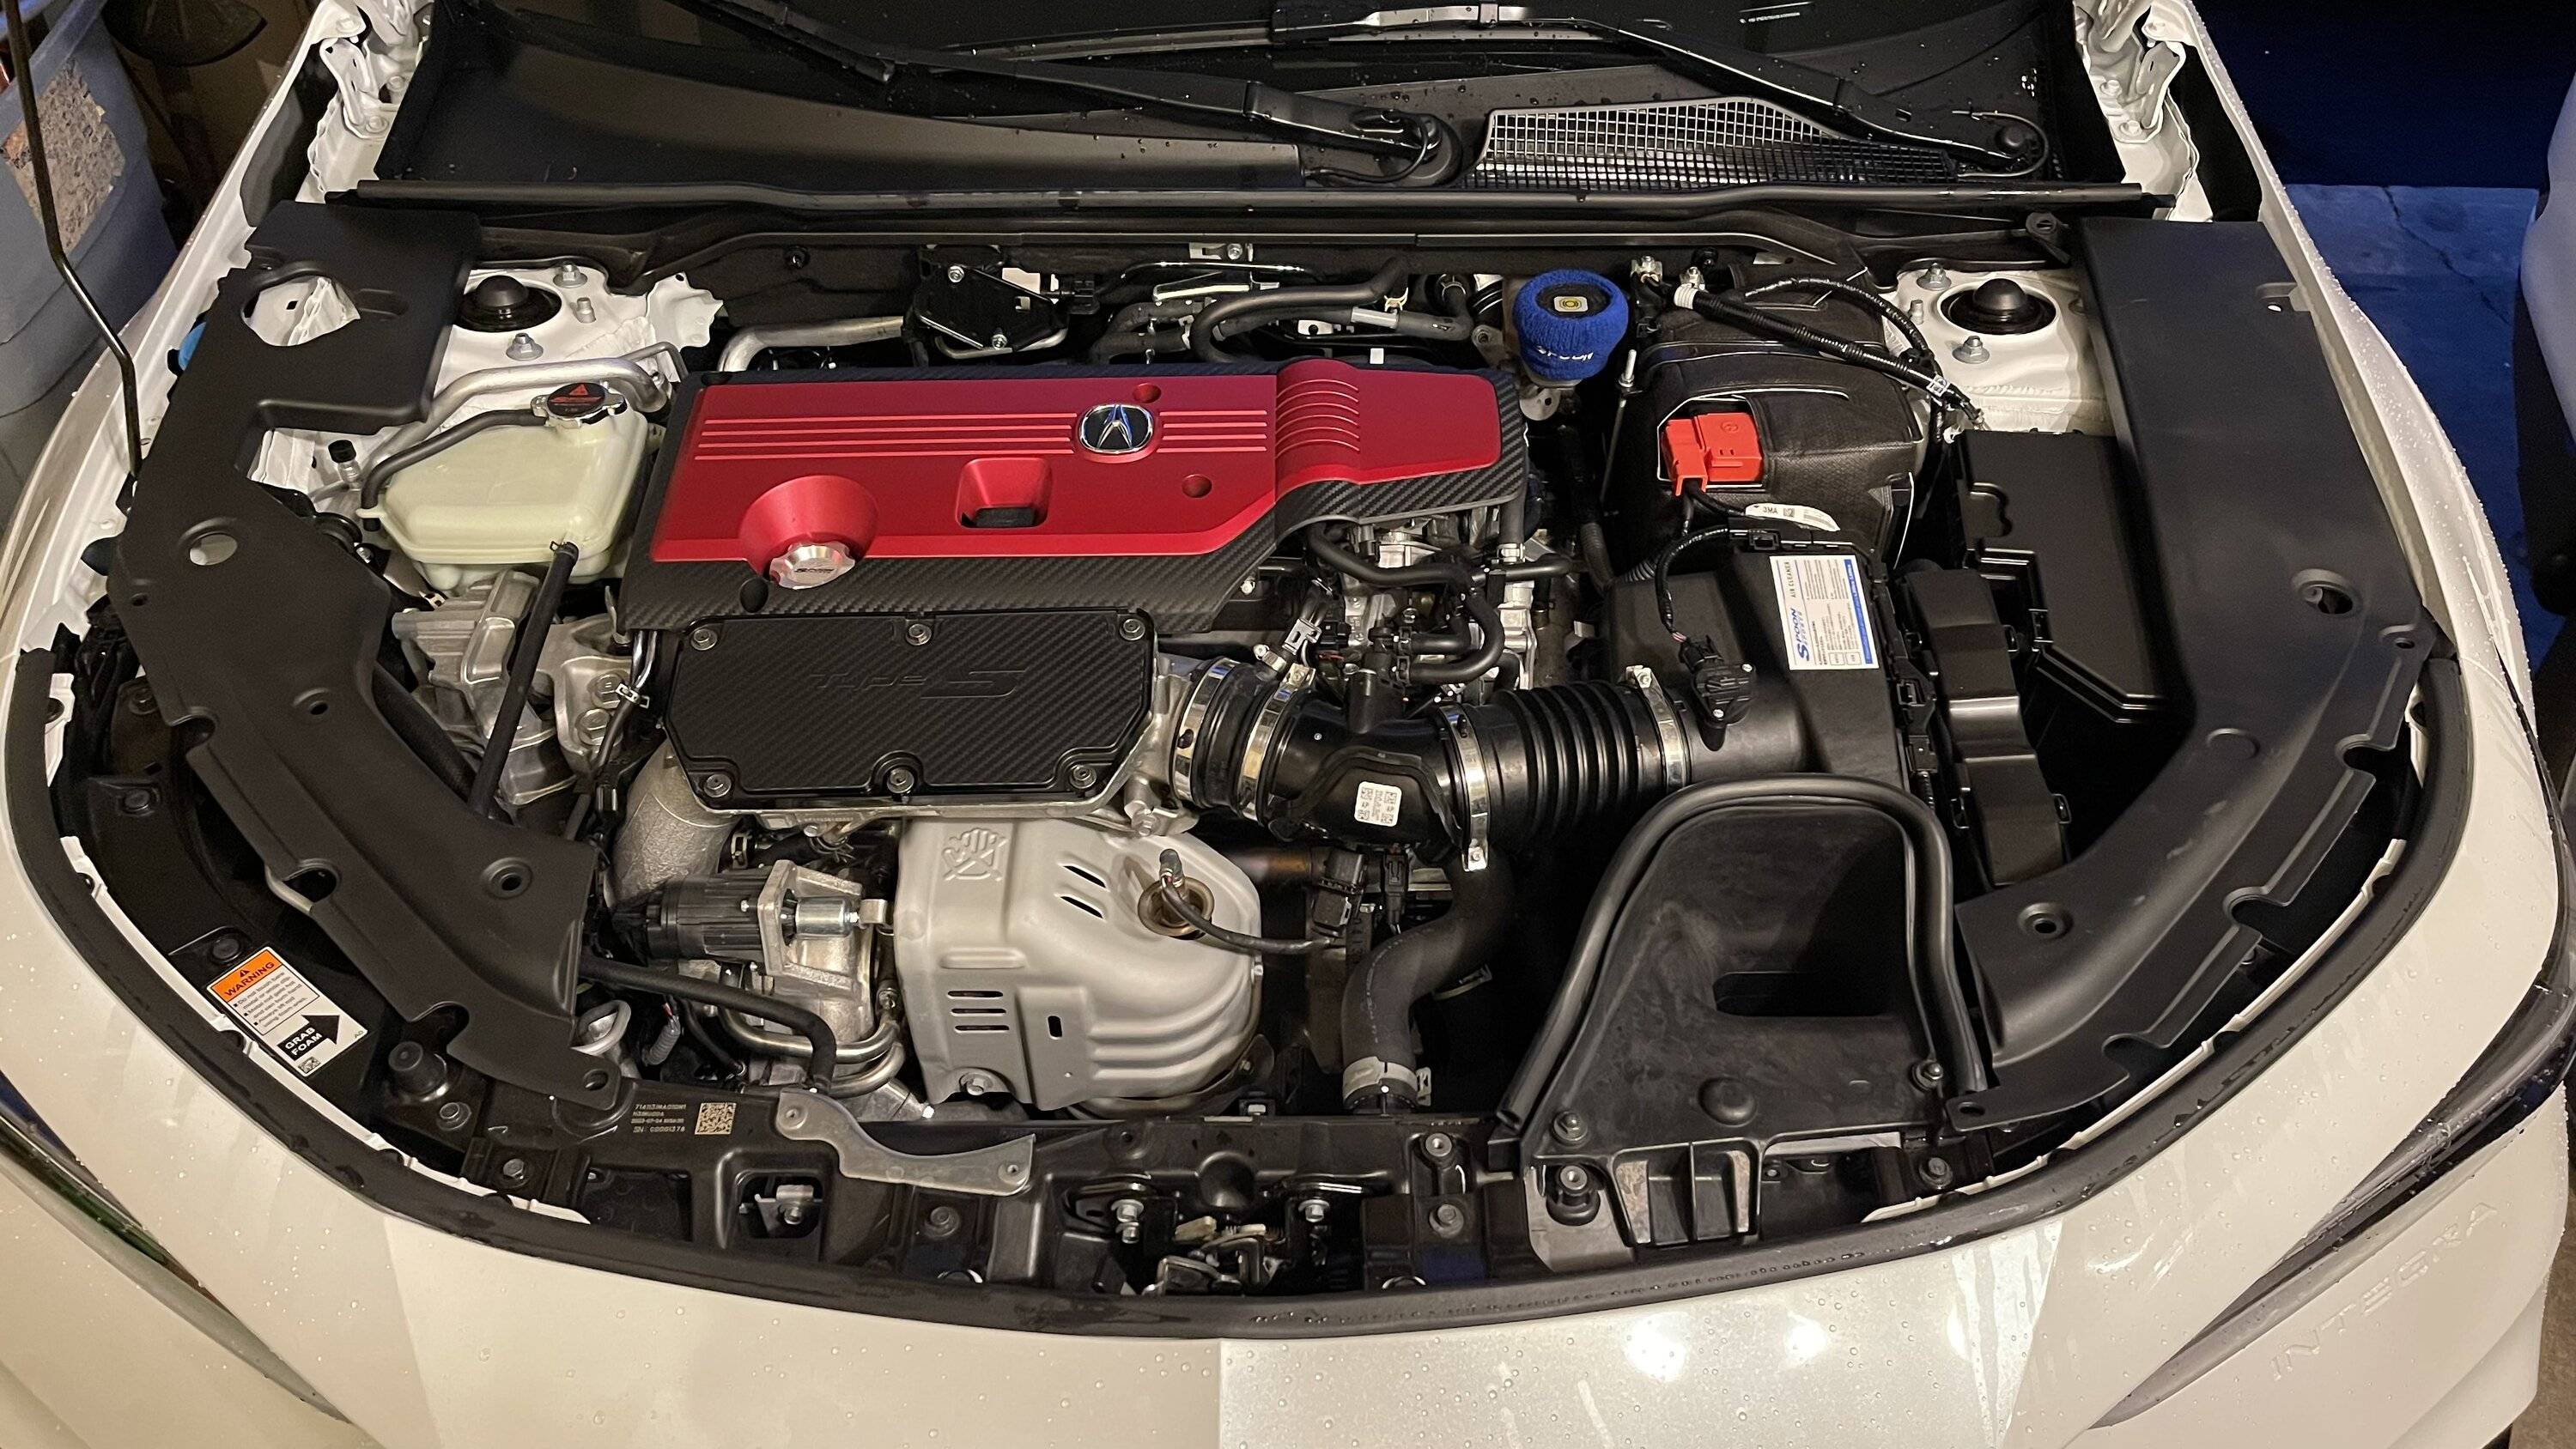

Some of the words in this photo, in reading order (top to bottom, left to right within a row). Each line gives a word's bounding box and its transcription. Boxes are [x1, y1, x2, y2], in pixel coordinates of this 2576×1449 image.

[1784, 561, 1795, 587] CLEANER
[1790, 607, 1809, 662] SPOON
[920, 665, 1030, 700] S
[224, 961, 275, 997] WARNING
[285, 1027, 315, 1050] GRAB
[291, 1033, 323, 1056] FOAM
[2269, 1202, 2498, 1381] INTEGRA
